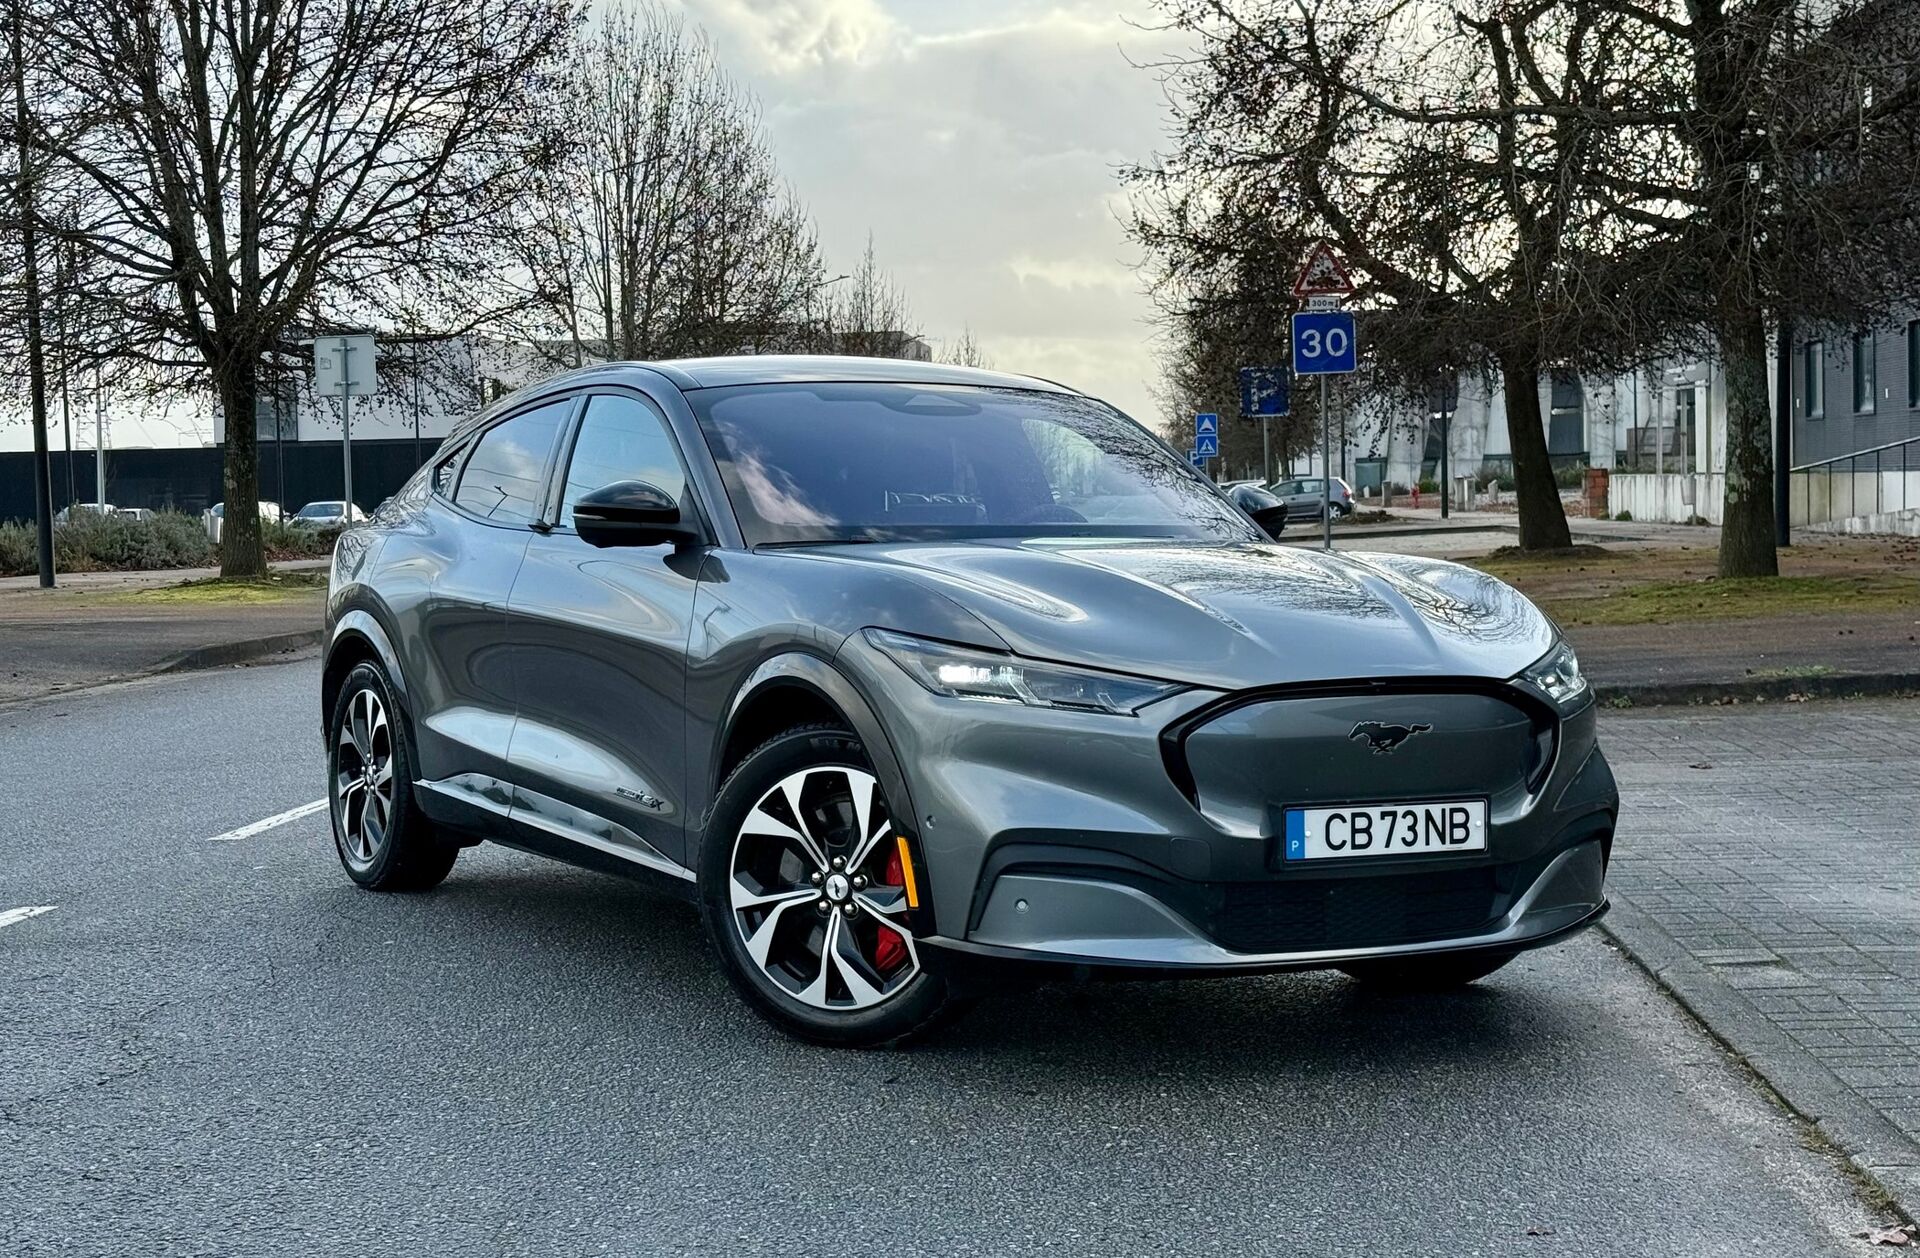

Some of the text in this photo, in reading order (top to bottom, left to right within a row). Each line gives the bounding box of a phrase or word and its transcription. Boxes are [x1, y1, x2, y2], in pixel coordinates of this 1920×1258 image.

[1301, 328, 1348, 358] 30
[1251, 373, 1279, 412] P
[1291, 840, 1299, 851] P
